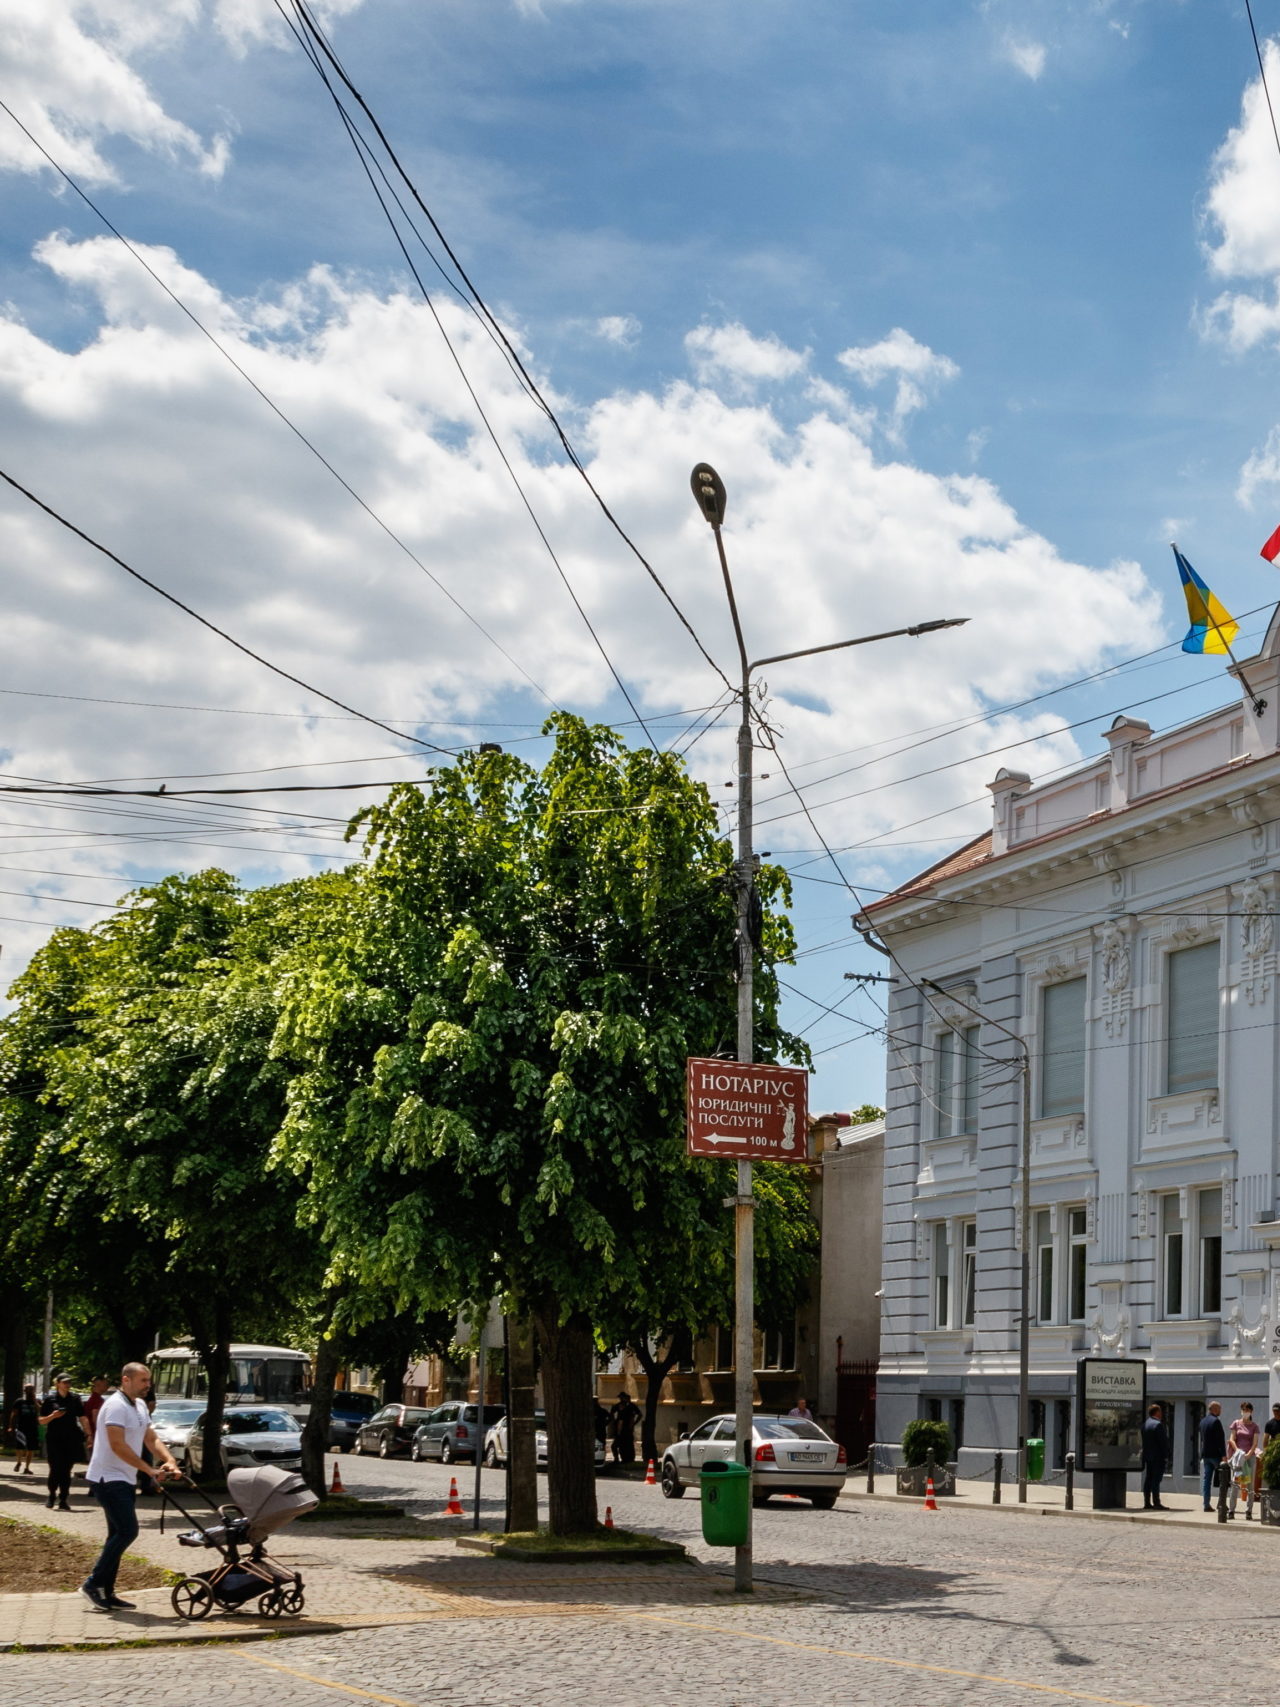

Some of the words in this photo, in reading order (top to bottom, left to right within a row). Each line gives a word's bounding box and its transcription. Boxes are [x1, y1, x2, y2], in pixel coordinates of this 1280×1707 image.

[701, 1073, 795, 1098] НОТАРІУС
[698, 1097, 772, 1115] ЮРИДИЧНІ
[698, 1112, 764, 1129] ПОСЛУГИ
[750, 1135, 767, 1146] 100
[1091, 1375, 1136, 1386] ВИСТАВКА
